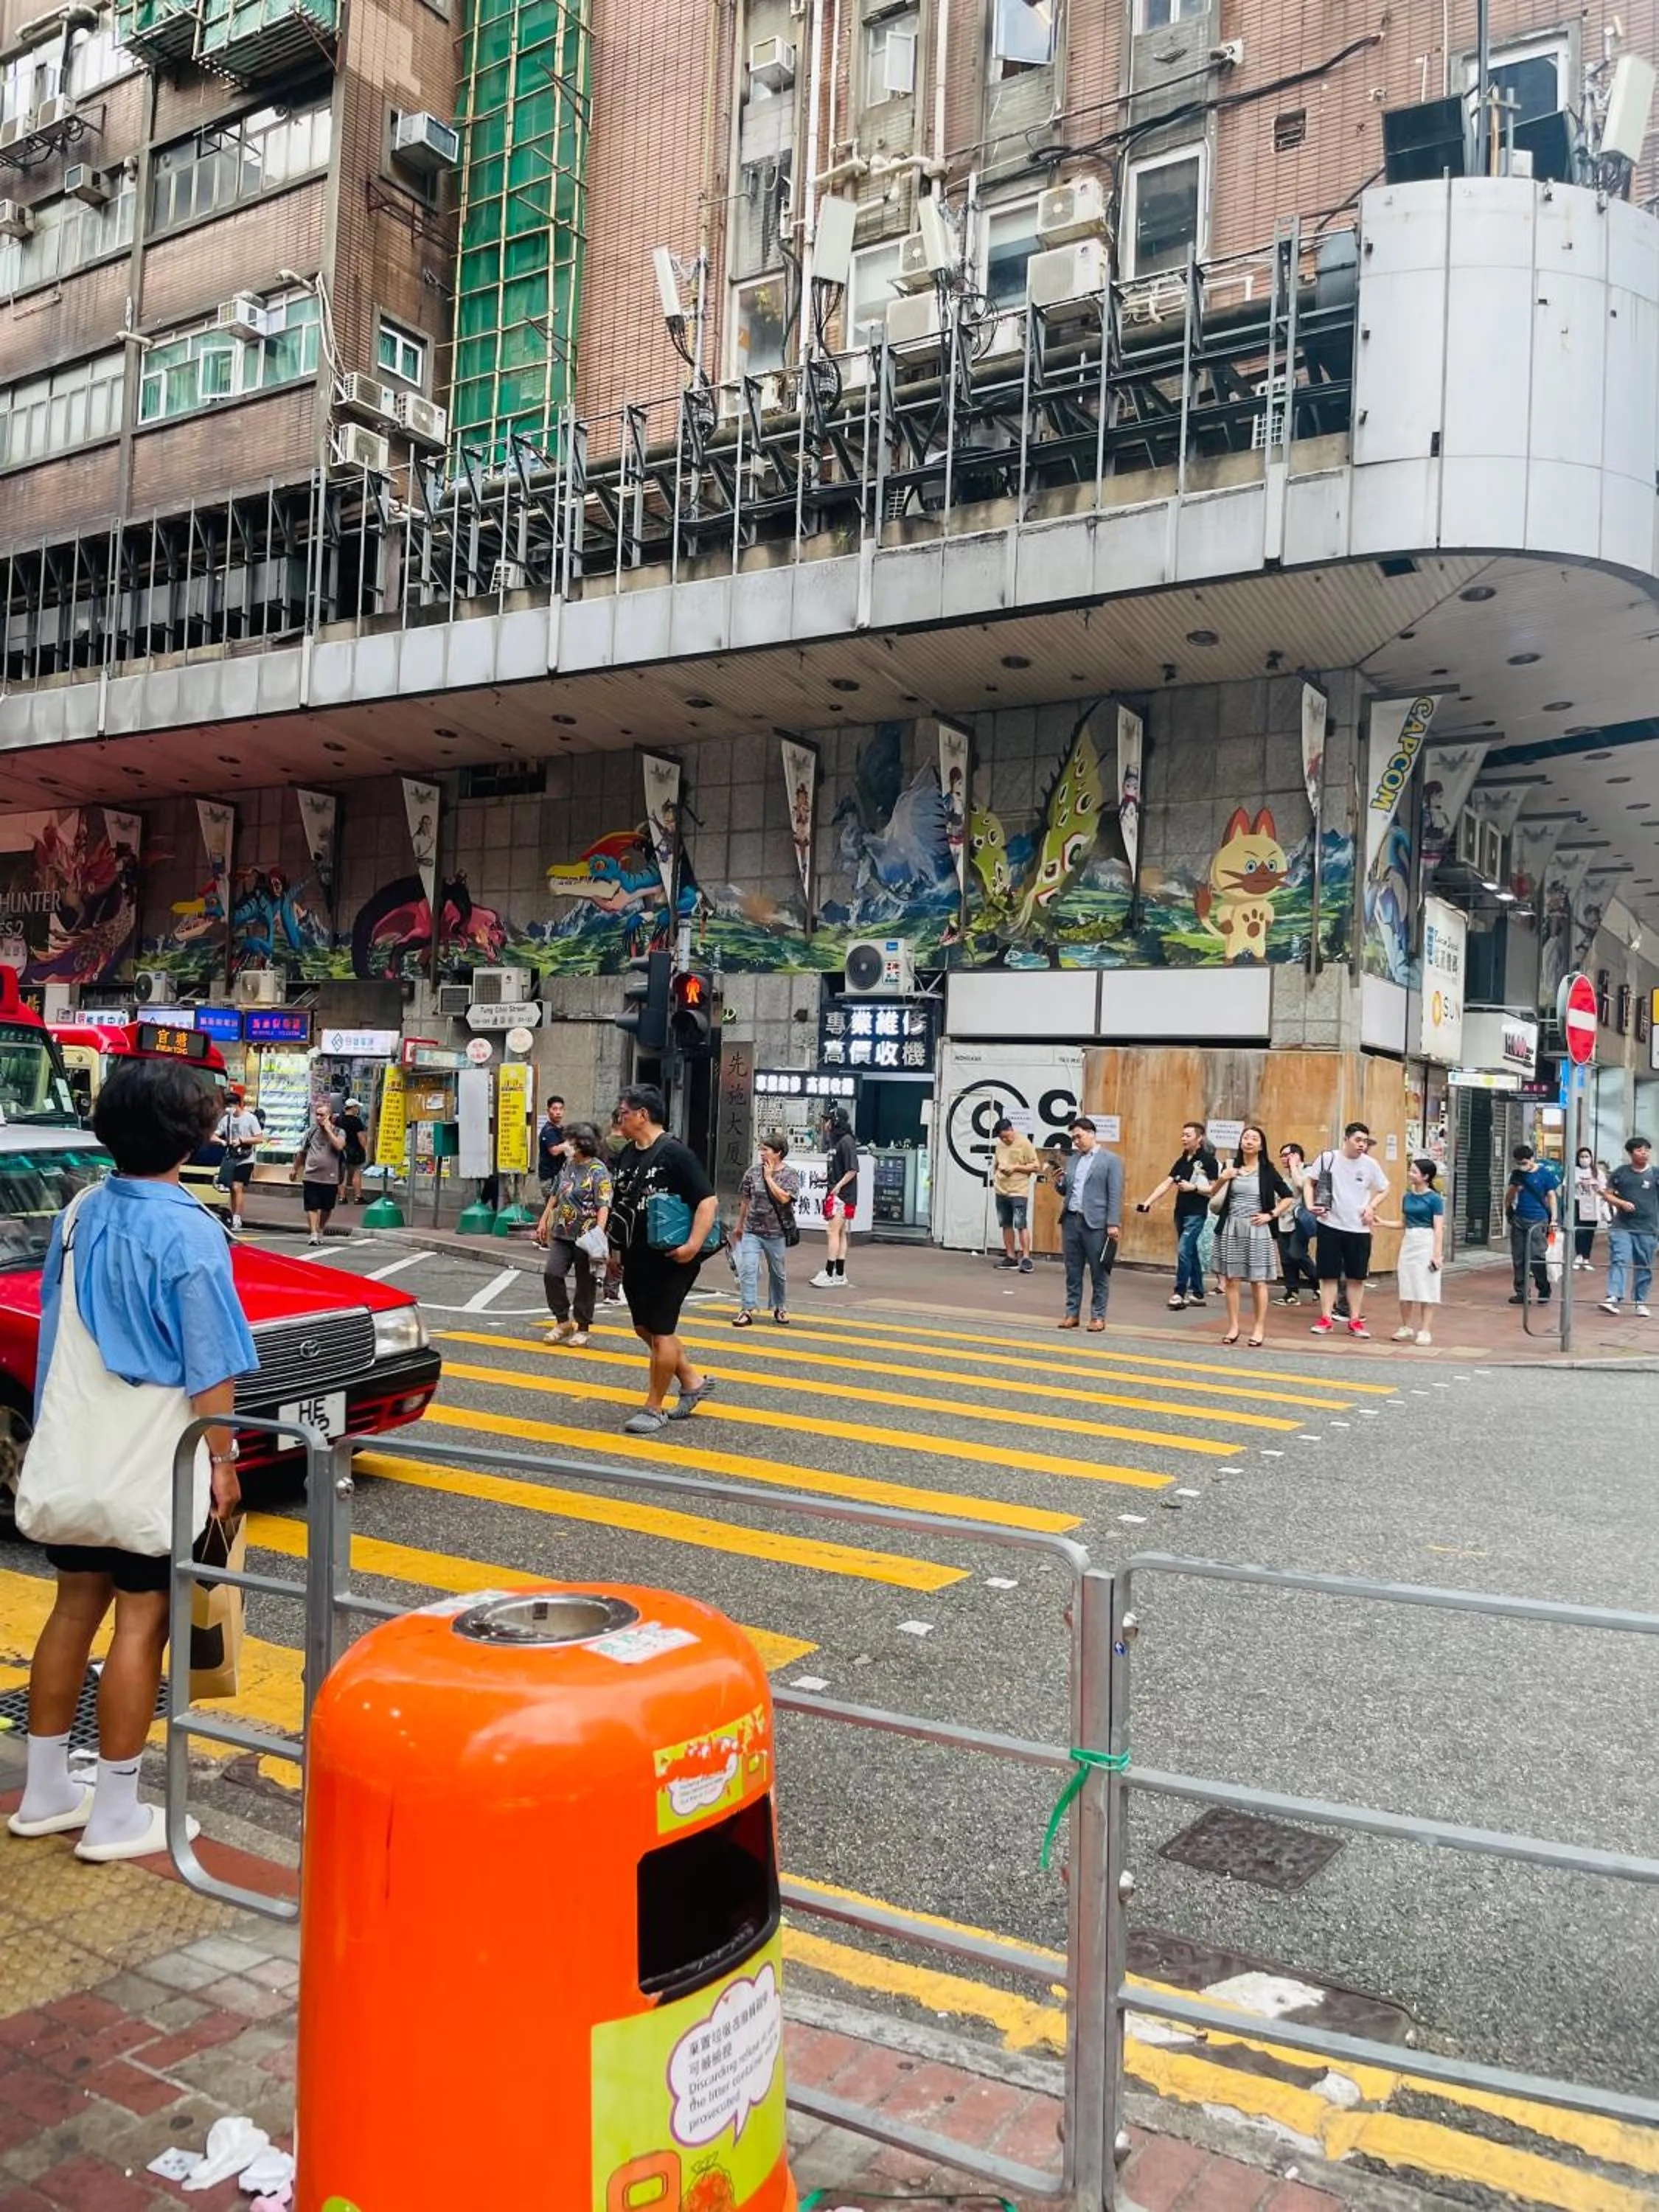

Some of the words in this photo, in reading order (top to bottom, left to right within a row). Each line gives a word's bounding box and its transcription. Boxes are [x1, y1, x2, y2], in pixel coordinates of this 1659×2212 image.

[1370, 696, 1434, 813] CAPCOM
[0, 890, 61, 912] HUNTER
[825, 1009, 928, 1035] 專業維修
[824, 1039, 926, 1066] 高價收機
[299, 1397, 325, 1423] HE
[689, 2059, 737, 2096] Discarding
[689, 2097, 706, 2112] the
[709, 2080, 730, 2102] litter
[689, 2088, 740, 2133] prosecuted
